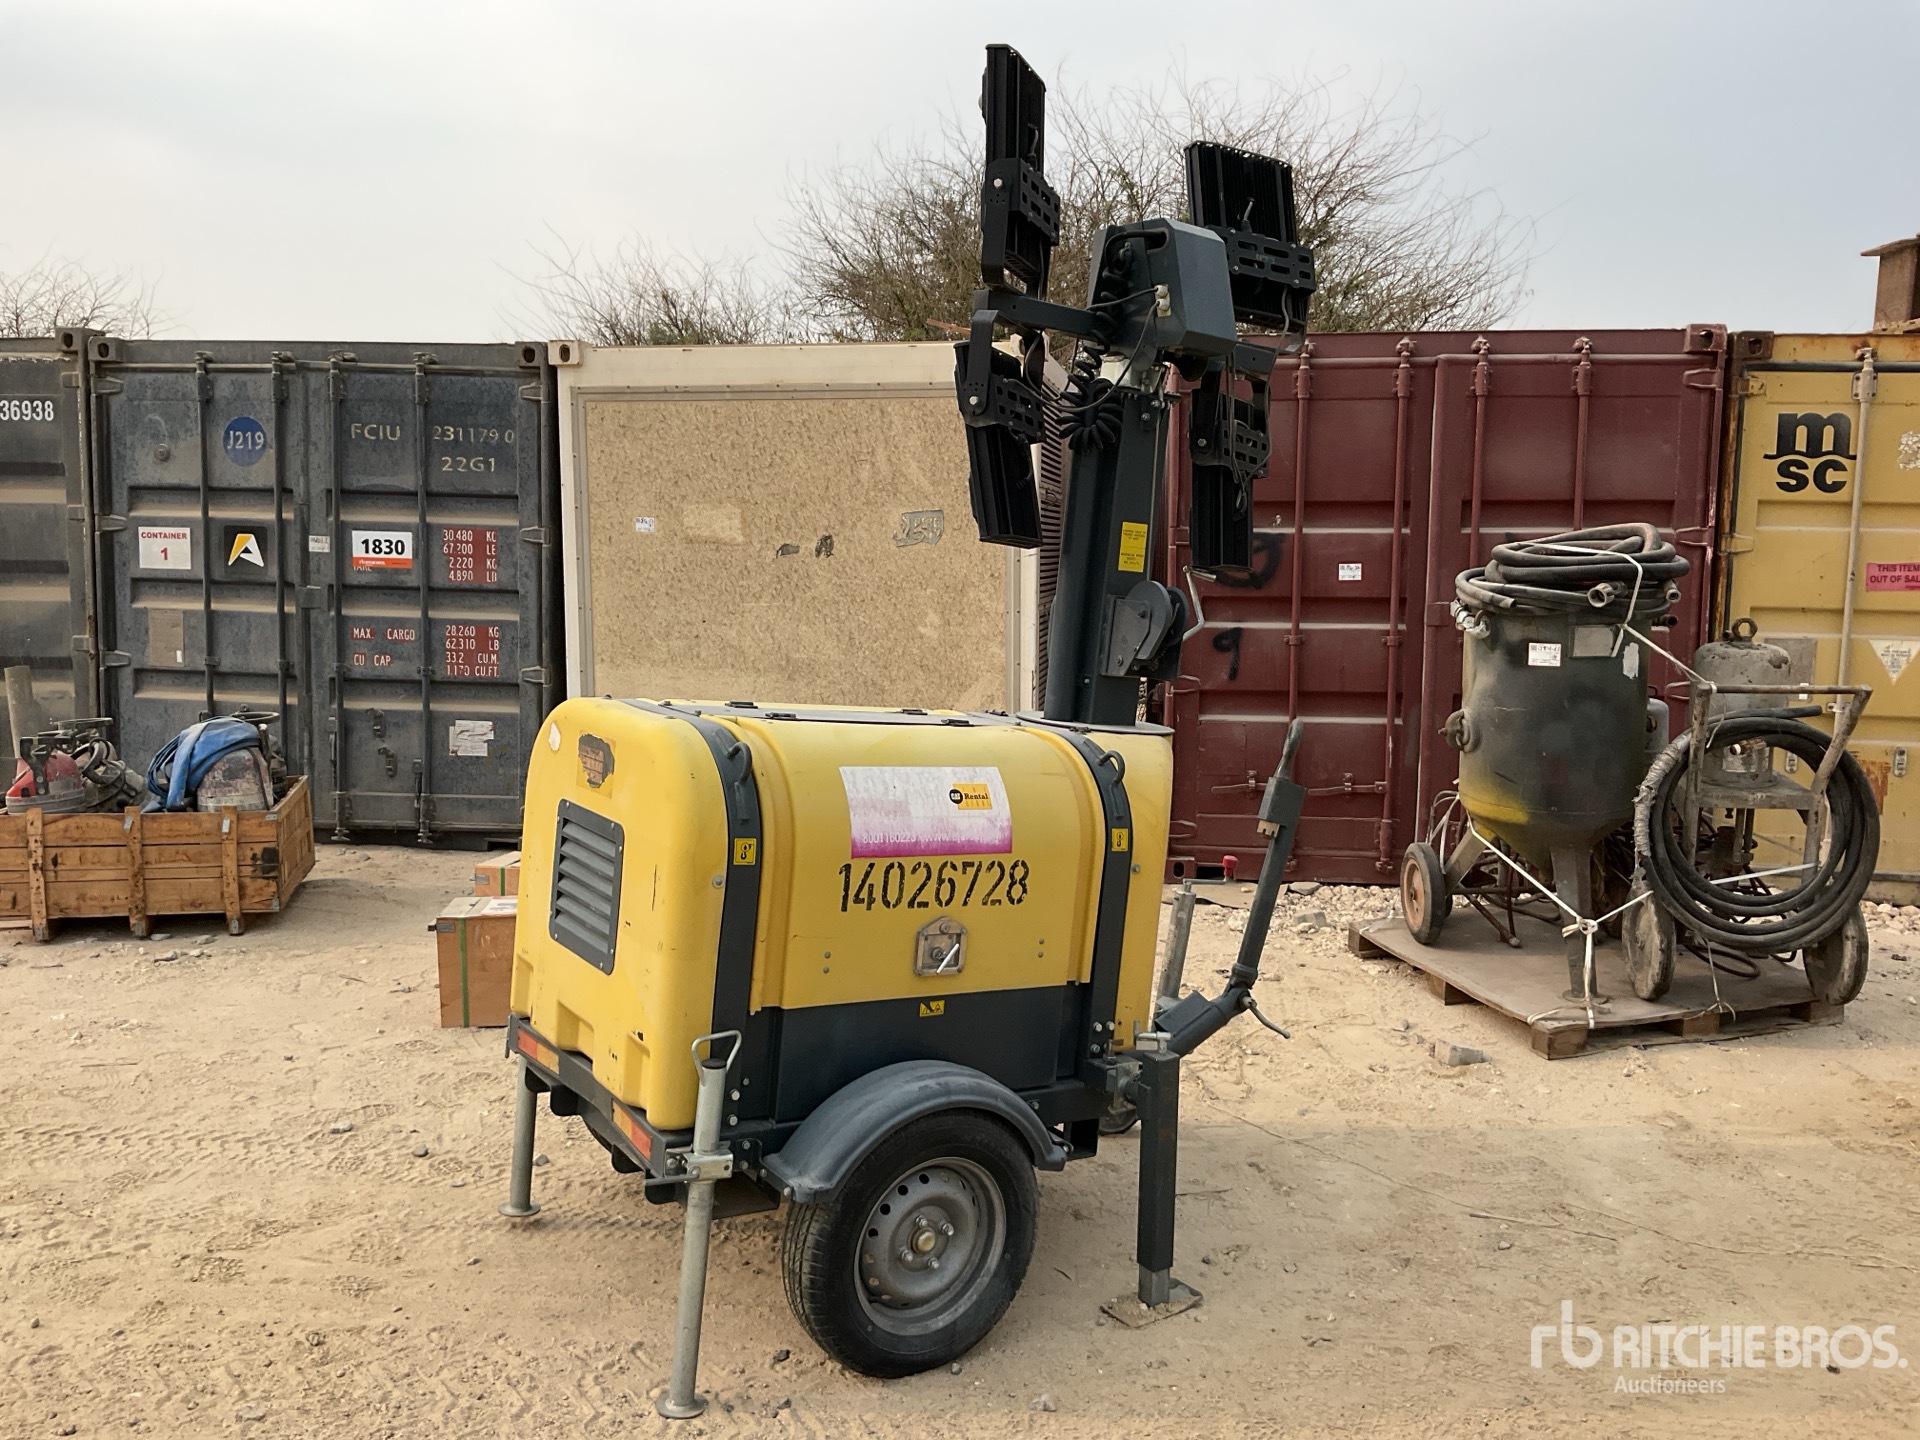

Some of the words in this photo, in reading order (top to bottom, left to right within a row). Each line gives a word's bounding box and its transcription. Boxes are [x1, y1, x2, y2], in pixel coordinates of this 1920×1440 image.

[351, 423, 401, 441] FCIU
[227, 431, 265, 450] J219
[441, 456, 496, 472] 22G1
[140, 531, 188, 540] CONTAINER
[443, 529, 473, 542] 30.480
[160, 547, 169, 561] 1
[361, 538, 406, 556] 1830
[1877, 563, 1898, 573] THIS
[1869, 575, 1888, 583] OUT
[1889, 575, 1902, 583] OF
[353, 628, 374, 639] MAX.
[386, 628, 416, 641] CARGO
[445, 625, 476, 637] 28.260
[488, 626, 499, 638] KG
[445, 638, 476, 650] 62.310
[488, 639, 500, 651] LB
[353, 654, 365, 666] CU
[445, 652, 465, 664] 33.2
[964, 792, 989, 800] Rental
[838, 859, 1030, 912] 14026728
